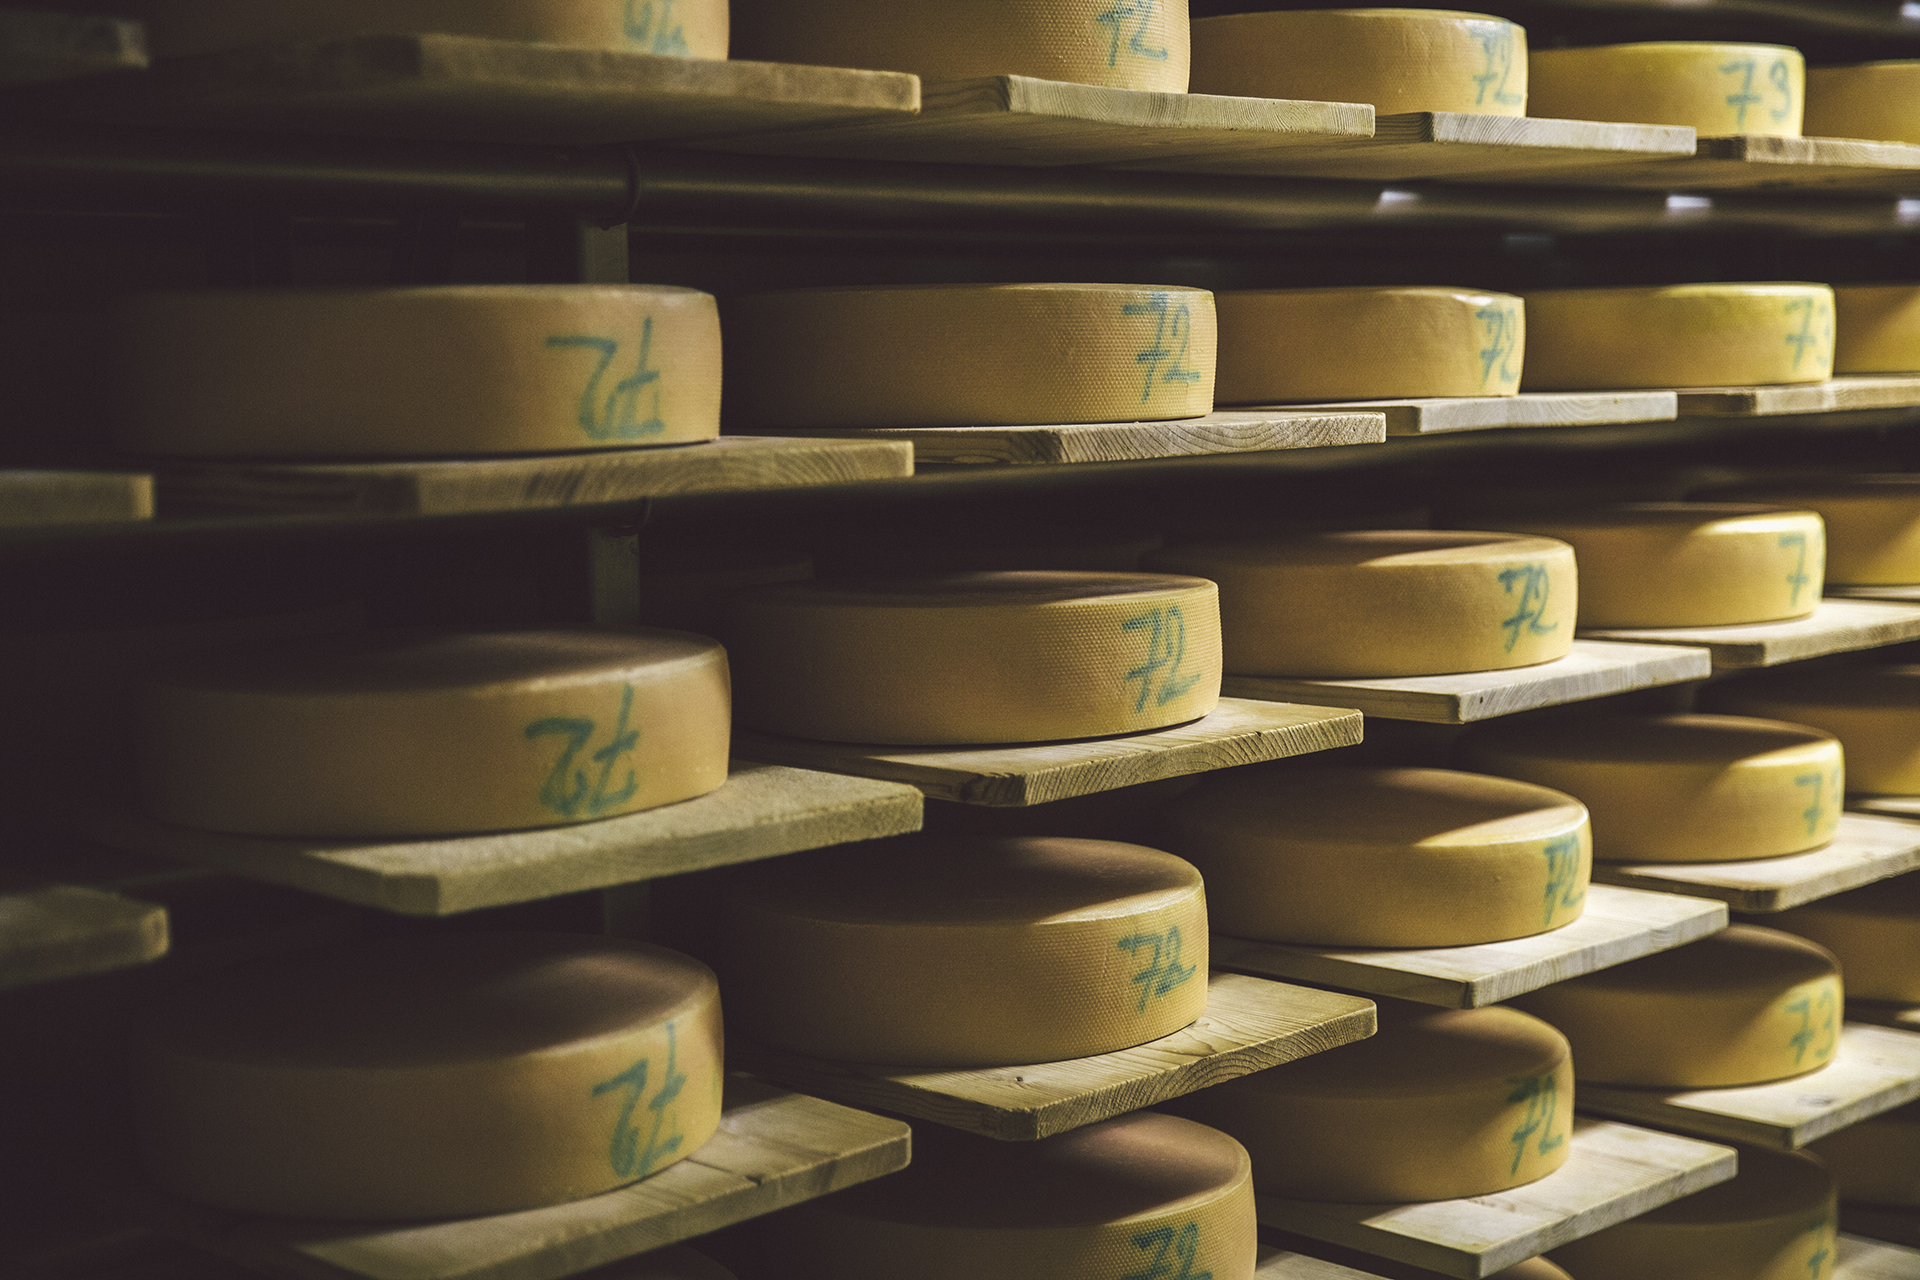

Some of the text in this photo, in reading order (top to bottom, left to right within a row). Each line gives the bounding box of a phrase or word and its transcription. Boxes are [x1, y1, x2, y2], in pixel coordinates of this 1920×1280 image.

[1096, 0, 1168, 66] 72
[1471, 20, 1521, 105] 72
[547, 318, 664, 440] 72
[1123, 292, 1201, 402] 72
[1477, 309, 1522, 386] 72
[1499, 565, 1557, 652] 72
[1122, 606, 1201, 713] 72
[525, 682, 640, 815] 72
[1543, 834, 1584, 926] 72
[1118, 925, 1197, 1012] 72
[592, 1022, 686, 1180] 72
[1507, 1075, 1562, 1175] 72
